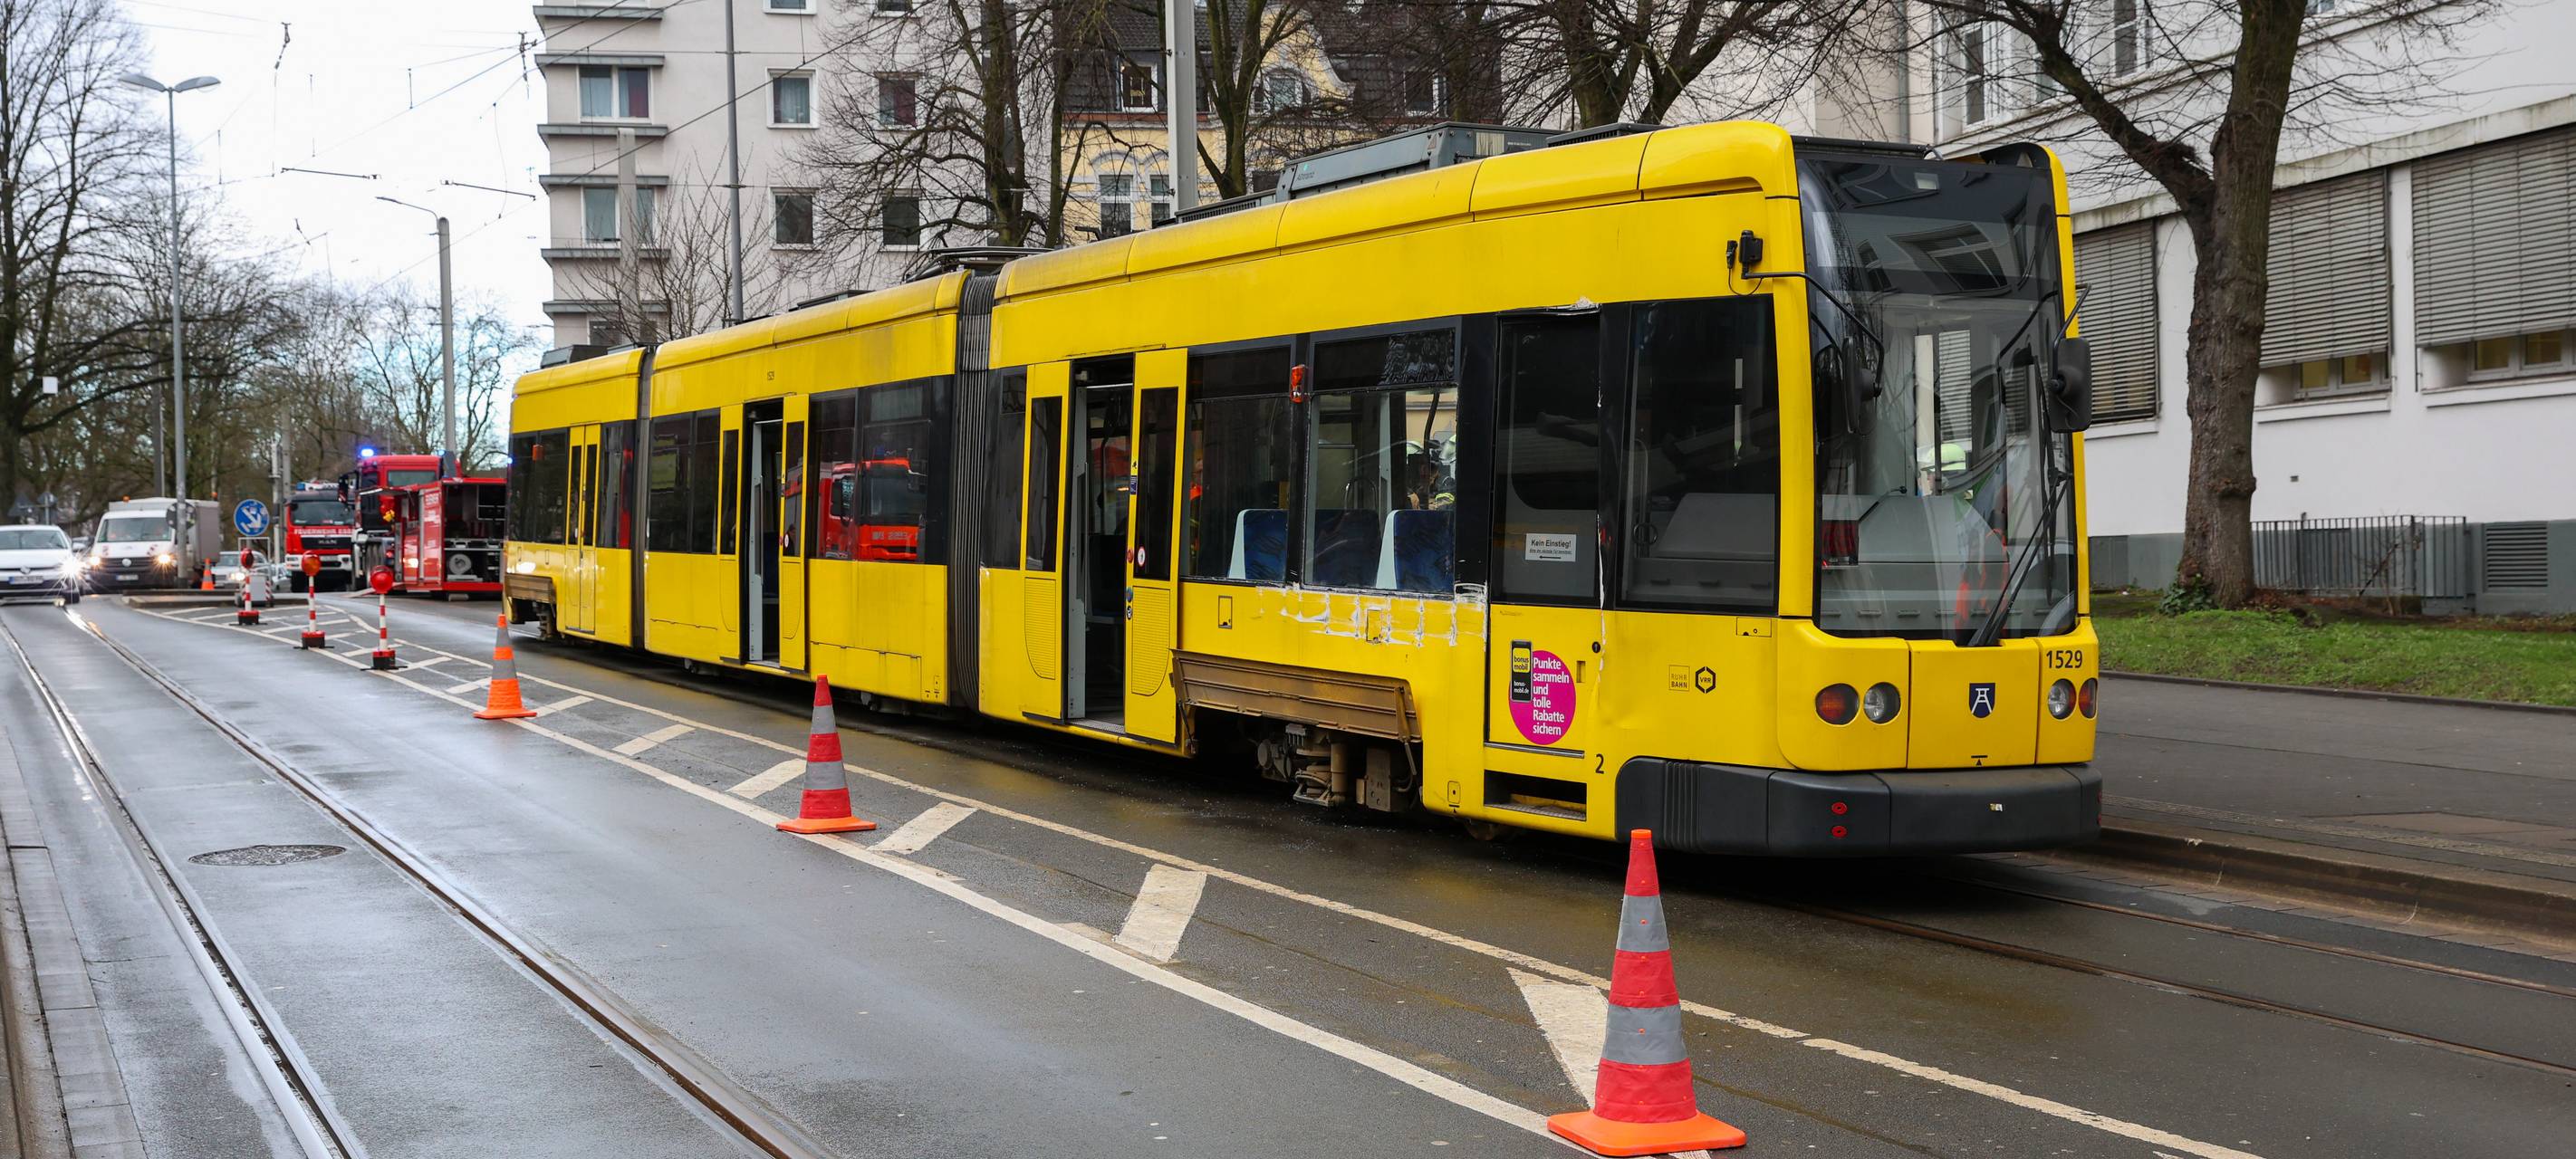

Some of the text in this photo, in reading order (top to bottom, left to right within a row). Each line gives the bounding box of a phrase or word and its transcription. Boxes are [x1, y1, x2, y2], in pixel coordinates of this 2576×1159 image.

[1531, 539, 1572, 549] Kein Einstieg!
[1533, 656, 1562, 670] Punkte
[2046, 650, 2082, 669] 1529
[1514, 663, 1528, 671] mobil
[1533, 671, 1570, 684] sammeln
[1670, 673, 1687, 681] RUHR
[1533, 684, 1549, 695] und
[1533, 696, 1552, 709] tolle
[1533, 709, 1565, 723] Rabatte
[1533, 723, 1562, 736] sichern
[1595, 752, 1605, 774] 2
